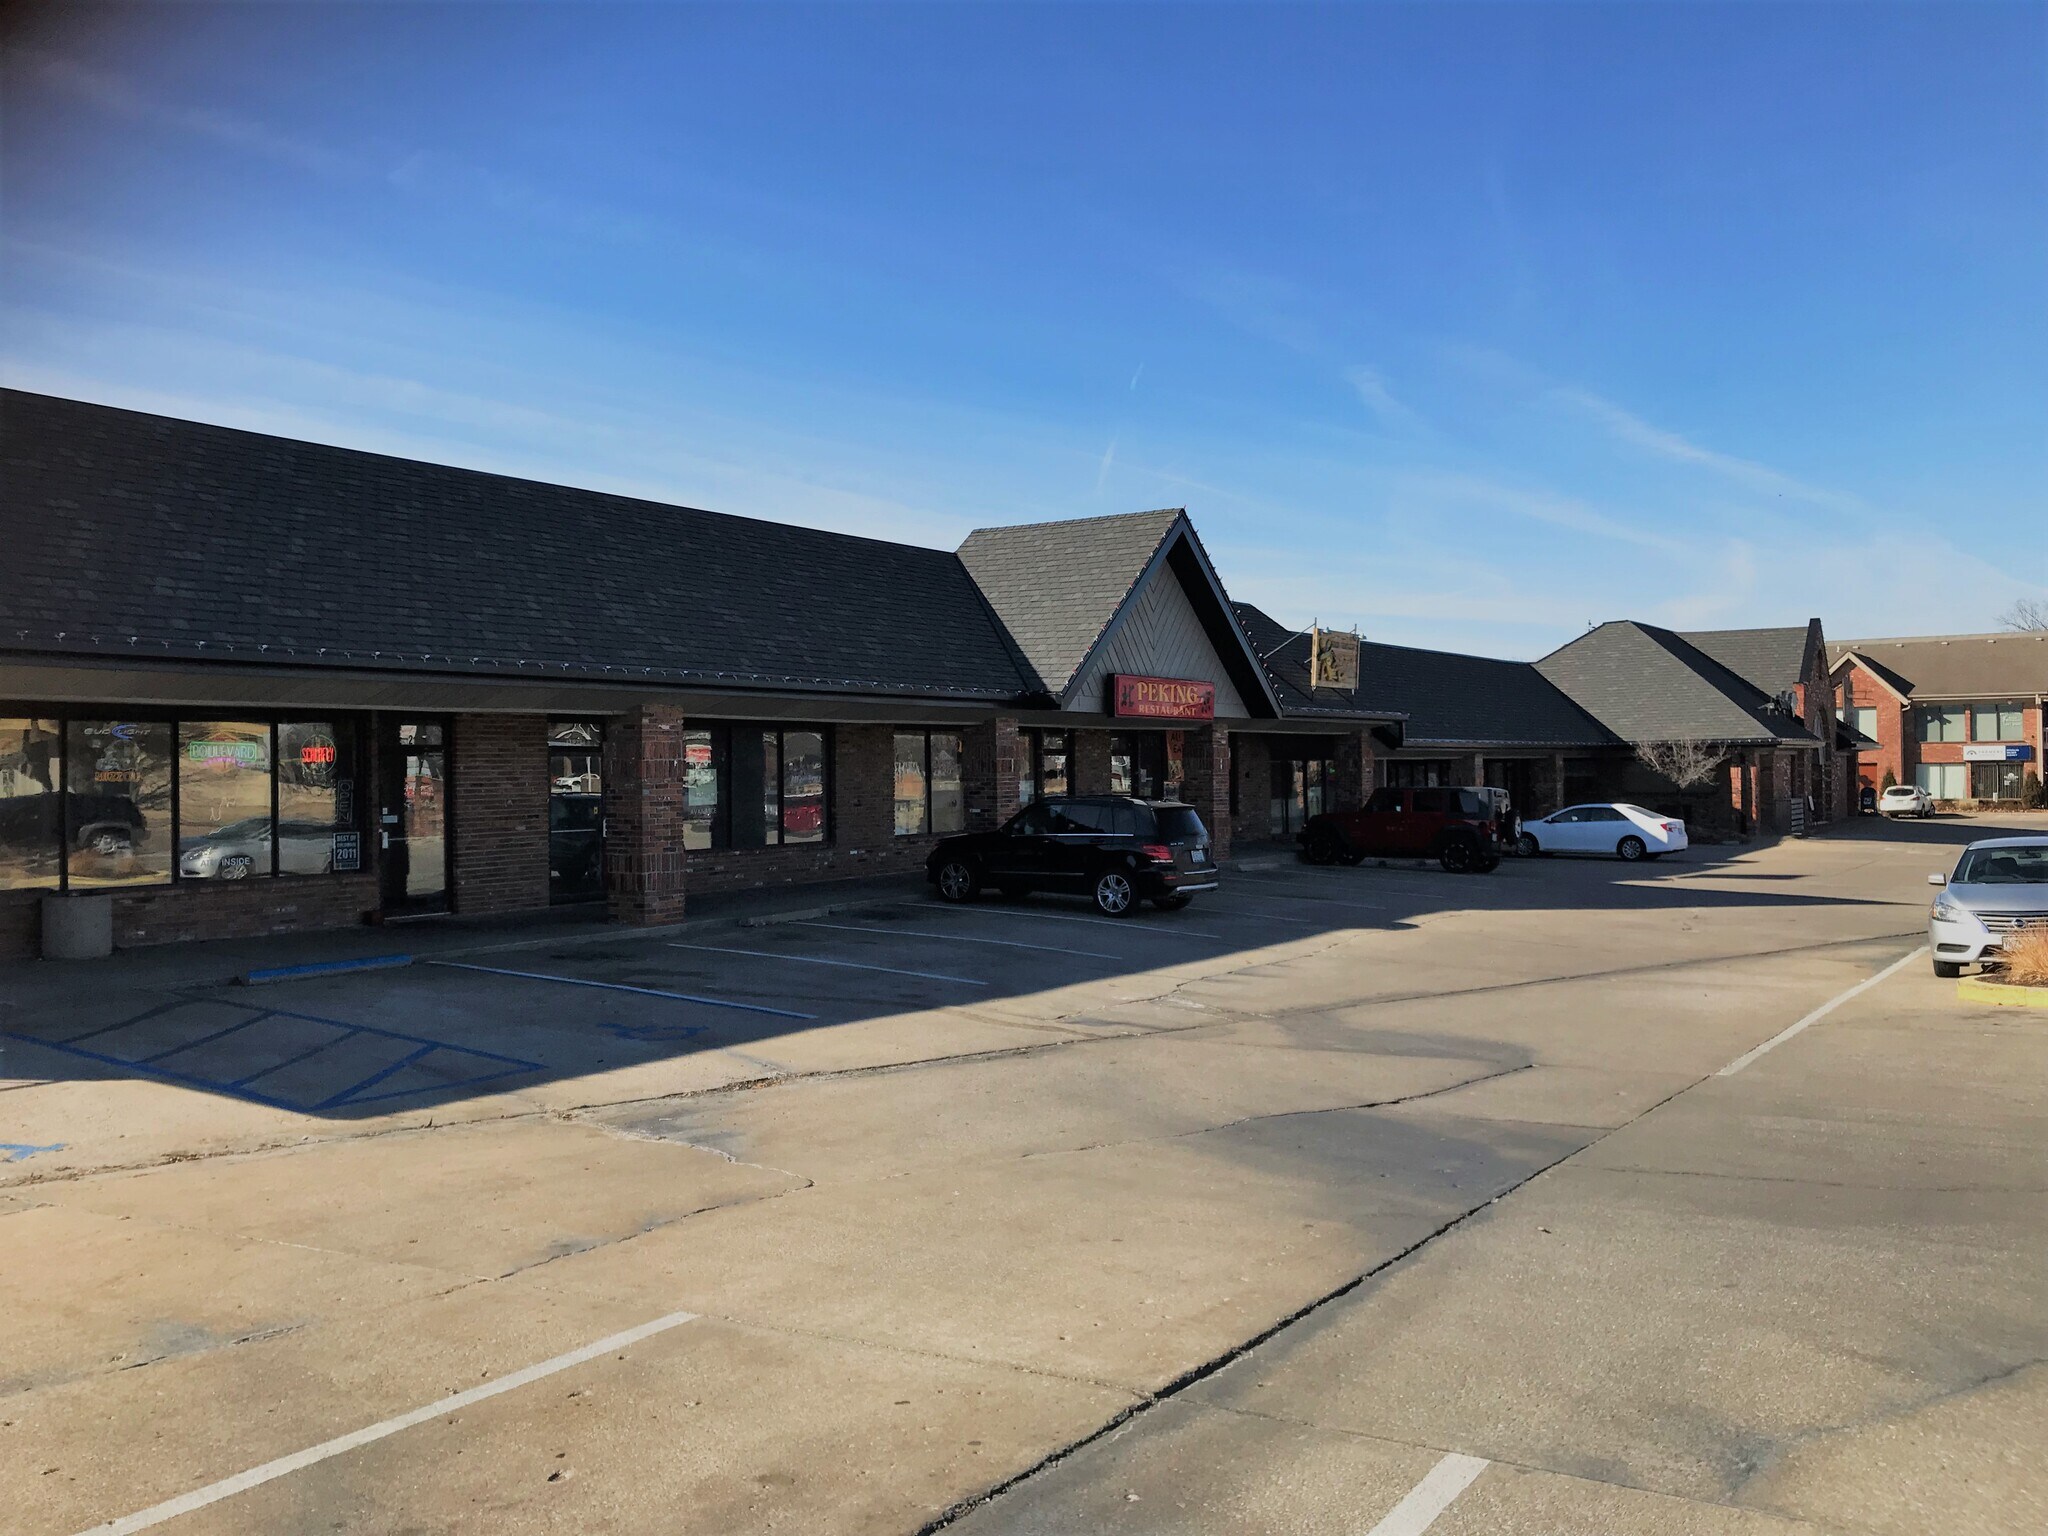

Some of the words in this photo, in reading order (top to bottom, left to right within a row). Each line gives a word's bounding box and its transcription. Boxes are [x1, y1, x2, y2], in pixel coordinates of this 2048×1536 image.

[1137, 681, 1199, 705] PEKING
[1138, 704, 1197, 716] RESTAURANT
[192, 744, 256, 759] BOULEVARD
[340, 782, 350, 822] OPEN
[336, 848, 357, 860] 2011
[221, 857, 251, 866] INSIDE
